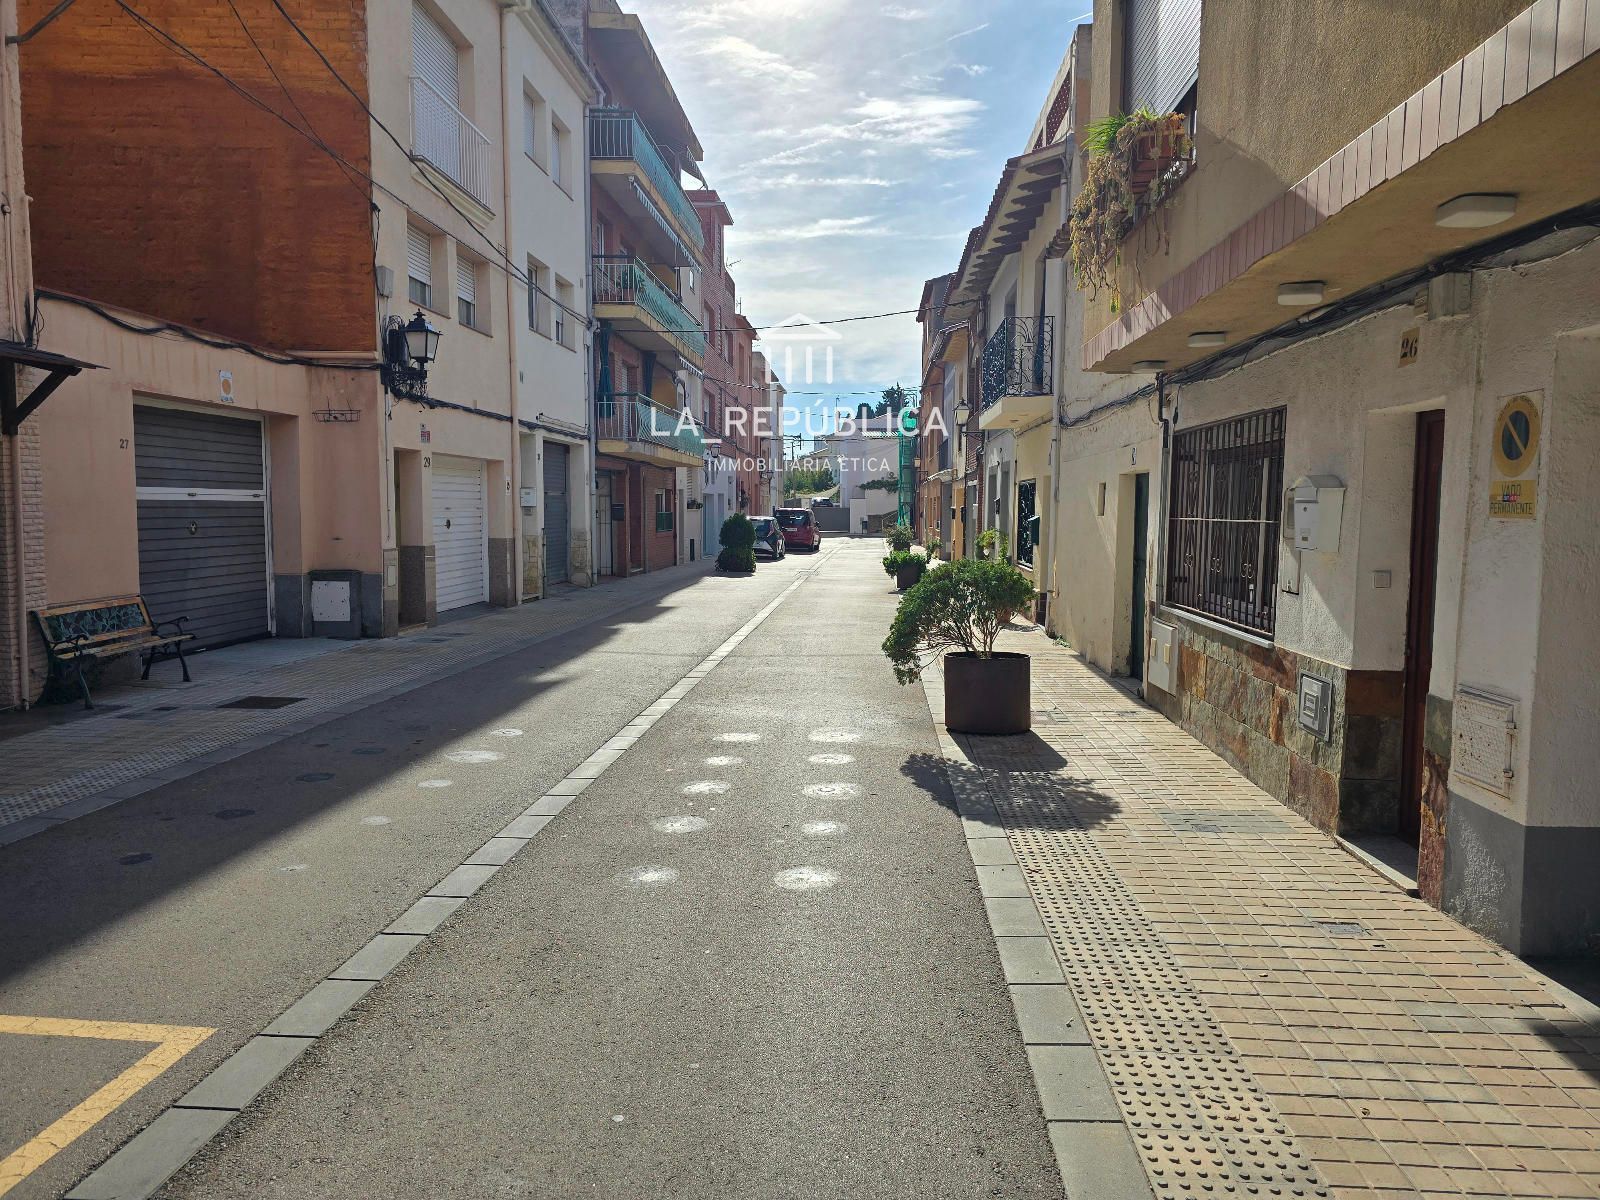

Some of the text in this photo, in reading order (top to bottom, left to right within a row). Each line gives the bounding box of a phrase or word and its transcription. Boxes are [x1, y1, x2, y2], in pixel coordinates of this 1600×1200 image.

[1400, 336, 1418, 359] 26
[119, 438, 129, 449] 27
[423, 456, 431, 468] 29
[1489, 502, 1533, 515] PERMANENTE
